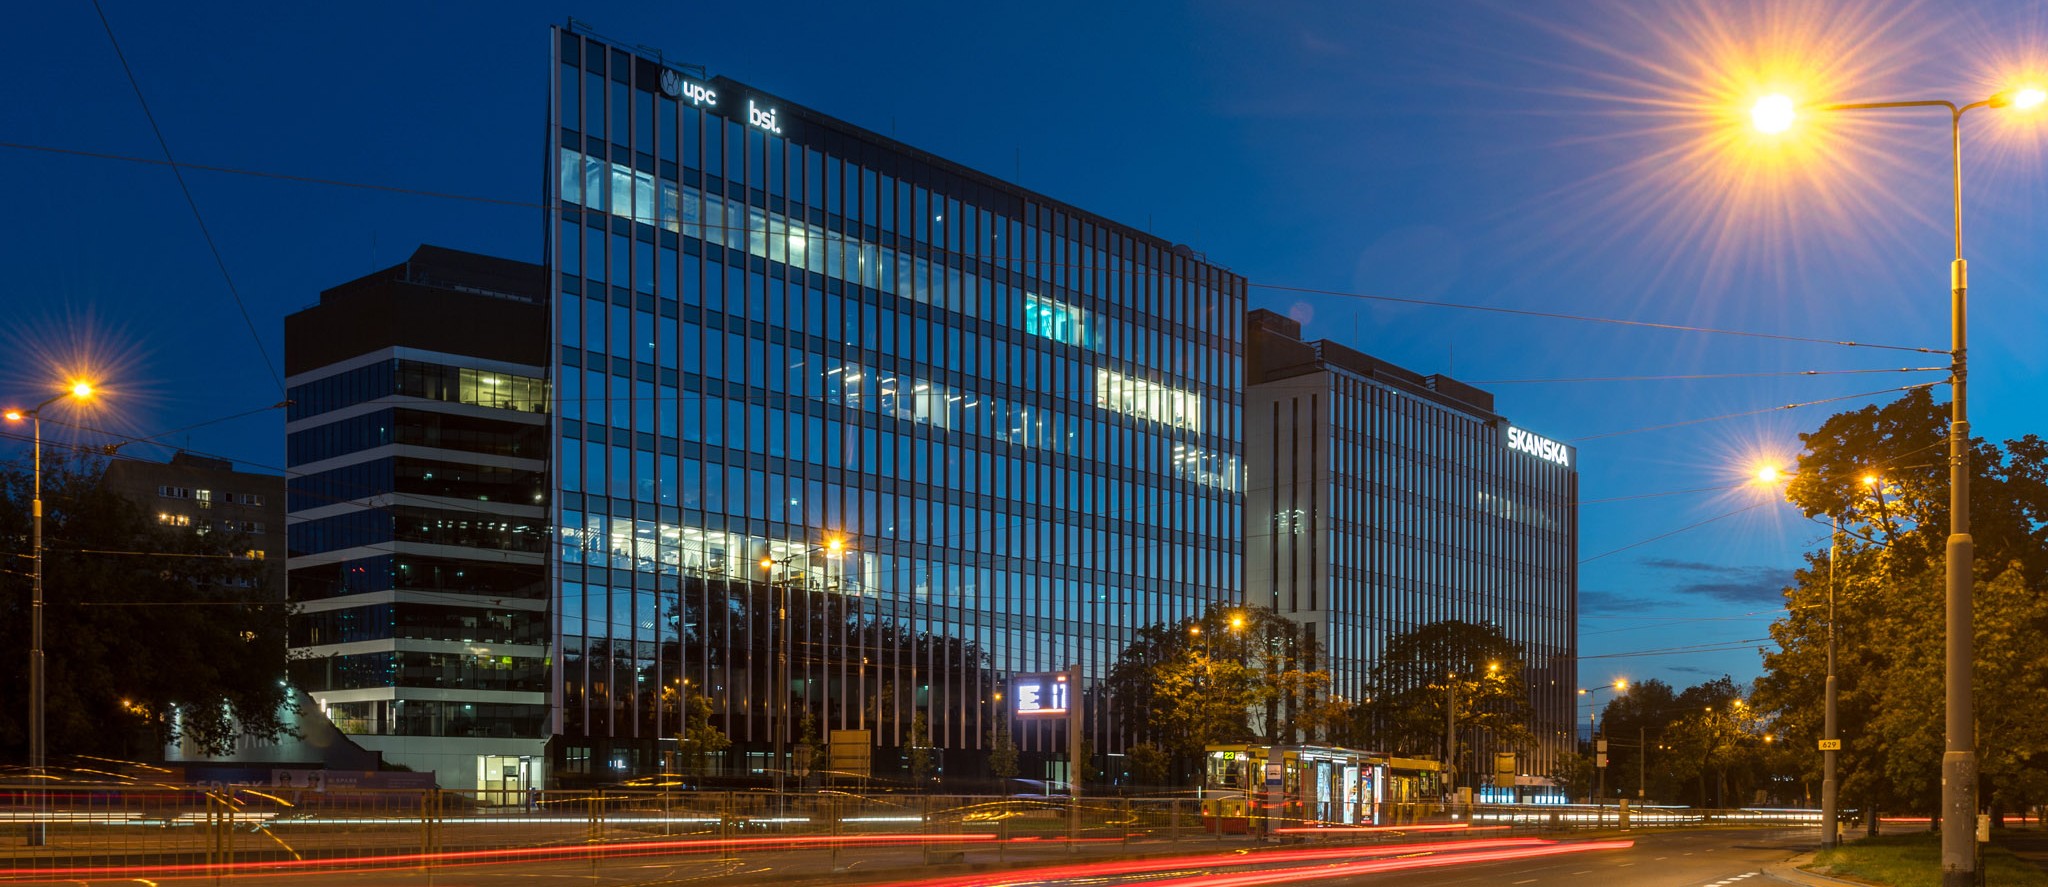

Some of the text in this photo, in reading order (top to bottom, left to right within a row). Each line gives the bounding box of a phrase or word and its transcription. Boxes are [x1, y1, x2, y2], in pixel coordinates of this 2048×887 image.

[683, 81, 717, 106] upc
[749, 99, 782, 134] bsi.
[1507, 426, 1569, 467] SKANSKA
[1224, 752, 1235, 760] 23
